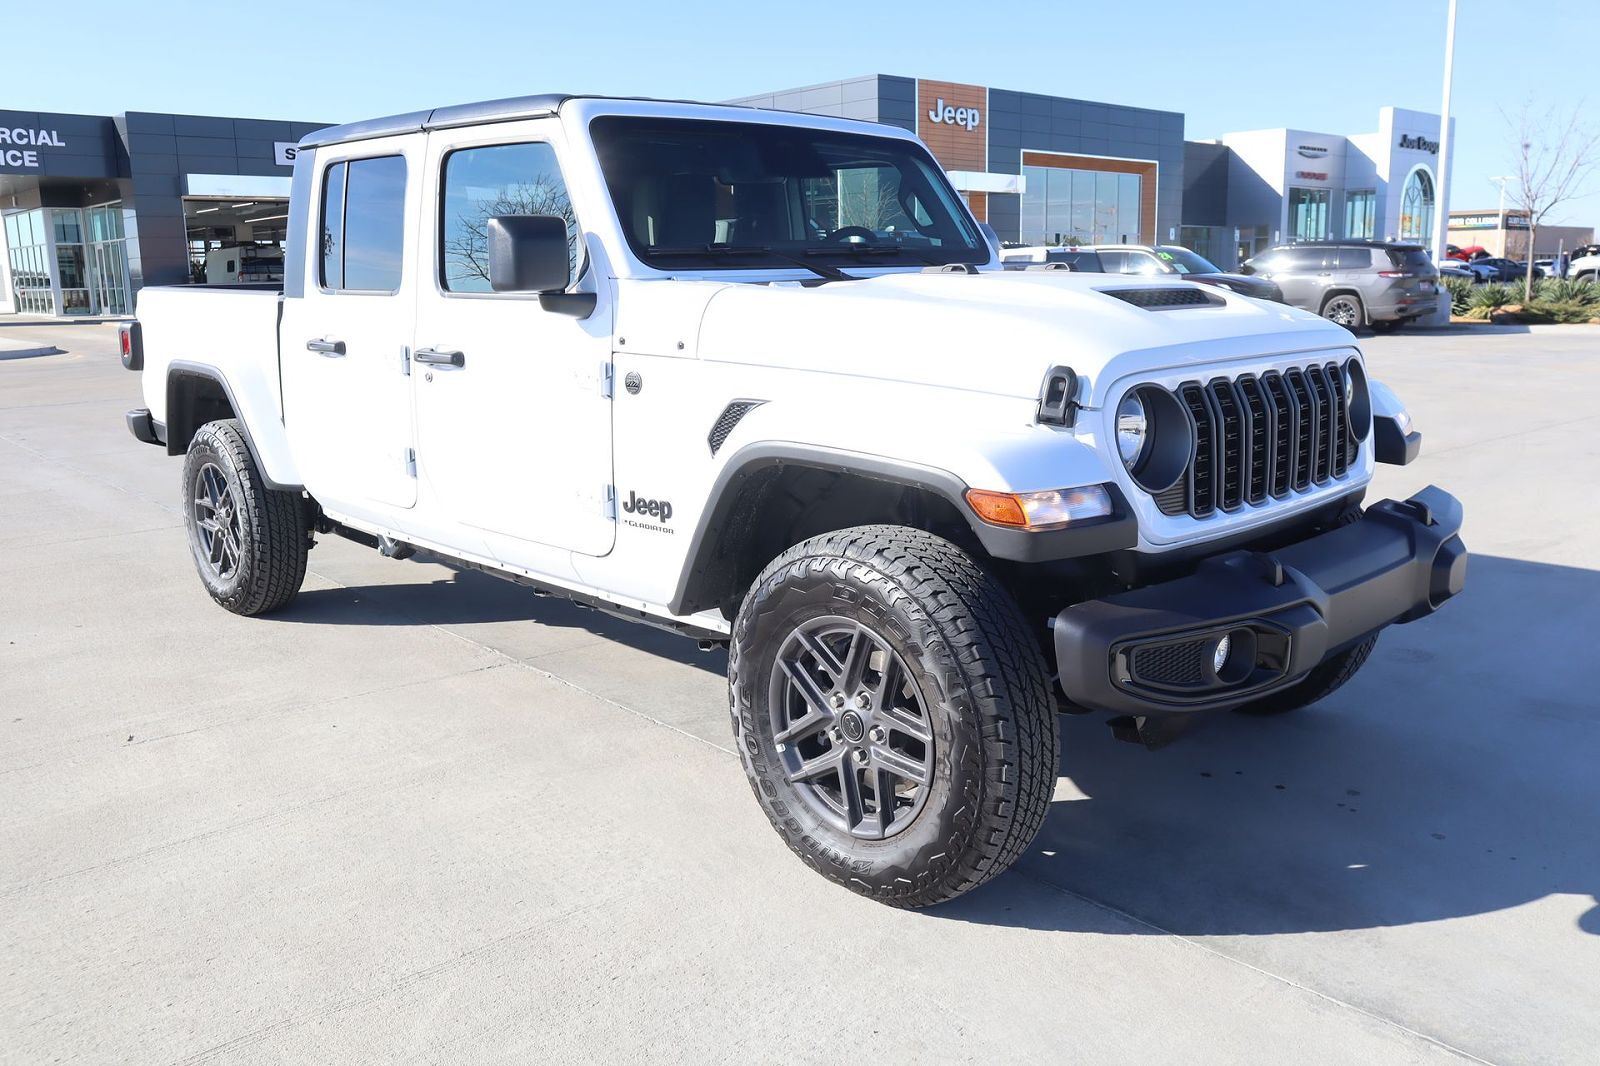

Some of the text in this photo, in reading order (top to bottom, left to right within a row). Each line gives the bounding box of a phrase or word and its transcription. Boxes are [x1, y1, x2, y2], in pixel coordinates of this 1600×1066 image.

[928, 97, 980, 131] Jeep
[0, 127, 66, 147] RCIAL
[622, 489, 673, 523] Jeep
[628, 520, 674, 535] GLADIATOR
